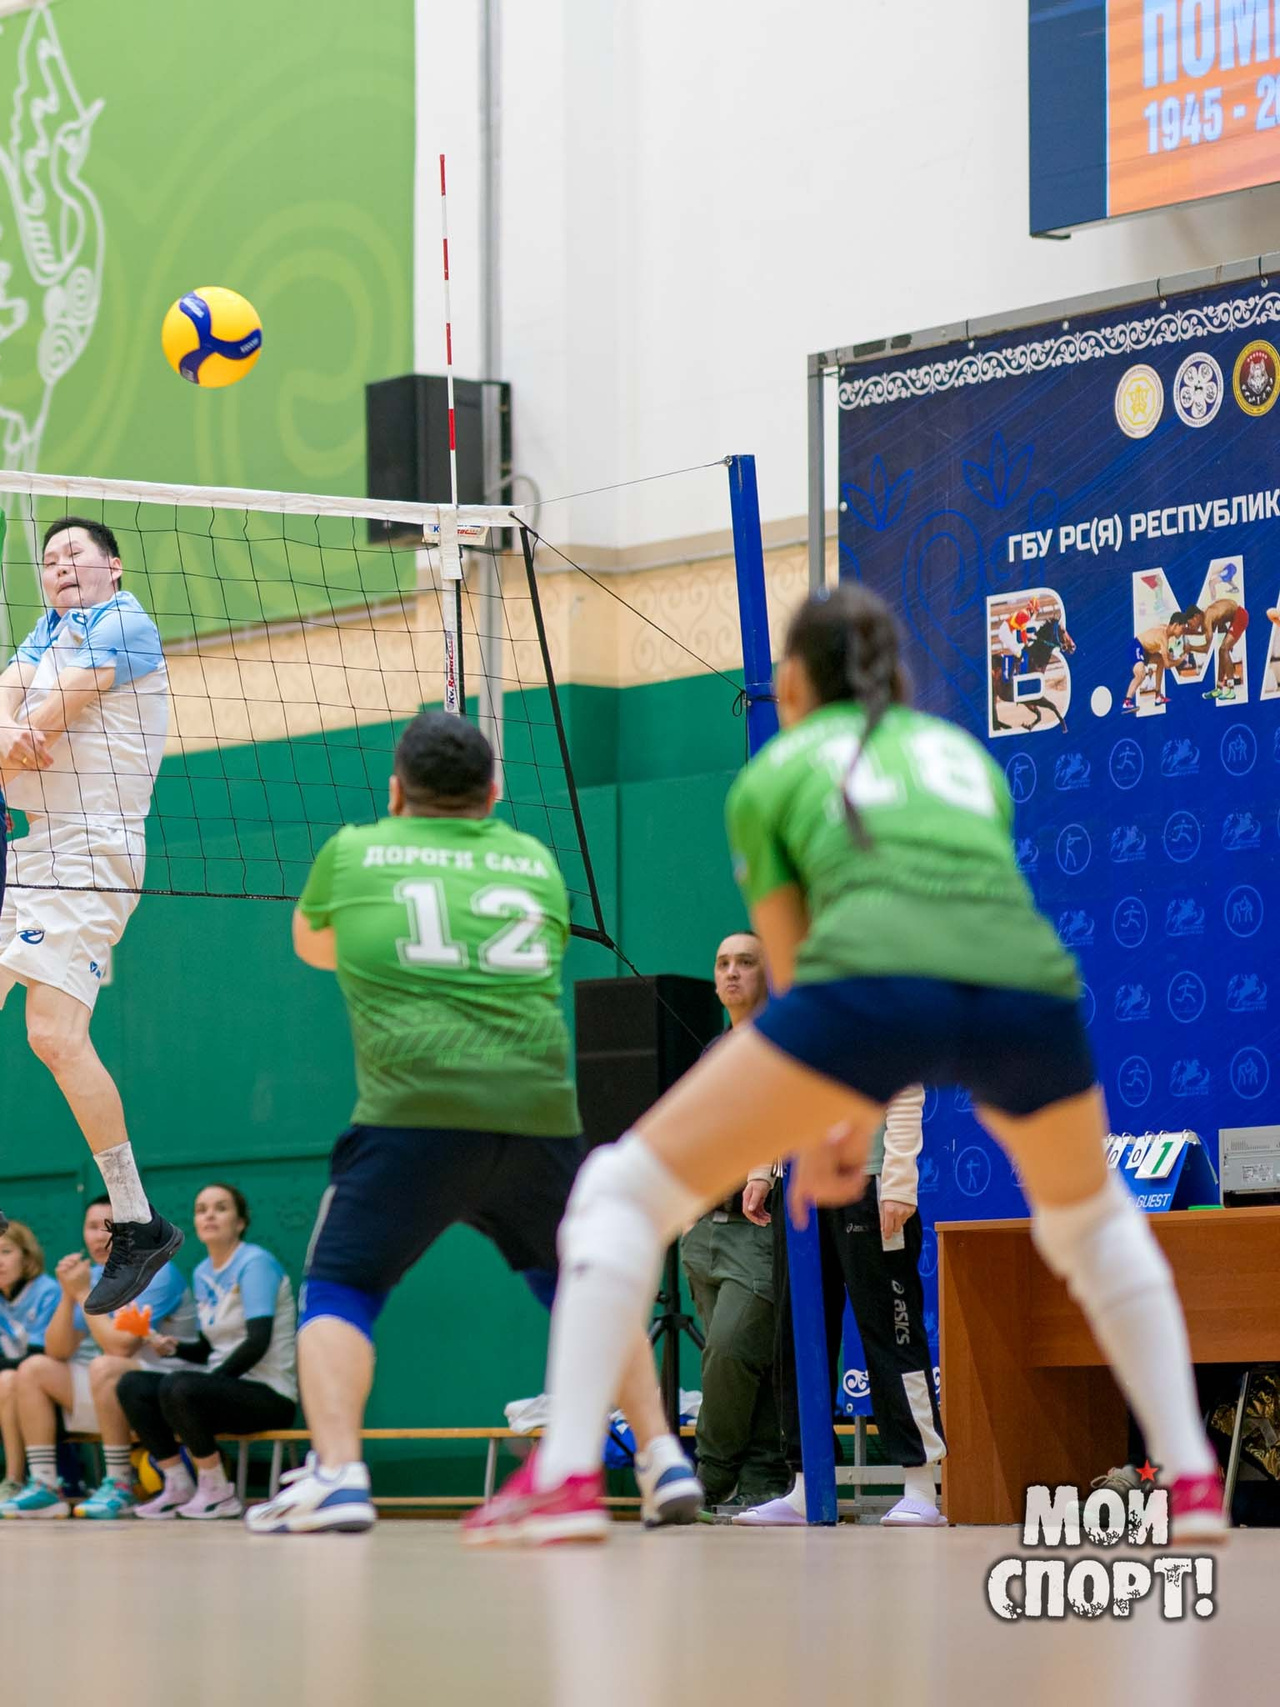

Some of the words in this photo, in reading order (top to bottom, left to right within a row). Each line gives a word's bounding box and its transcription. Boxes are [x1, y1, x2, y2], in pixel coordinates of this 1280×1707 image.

[1144, 87, 1223, 155] 1945
[1008, 529, 1053, 563] ГБУ
[1060, 513, 1123, 555] РС(Я)
[1130, 488, 1280, 541] РЕСПУБЛИК
[363, 844, 474, 870] ДОРОГИ
[484, 852, 548, 879] САХА
[394, 877, 553, 976] 12
[1150, 1141, 1174, 1175] 1
[1136, 1193, 1171, 1208] GUEST
[894, 1299, 911, 1345] asics
